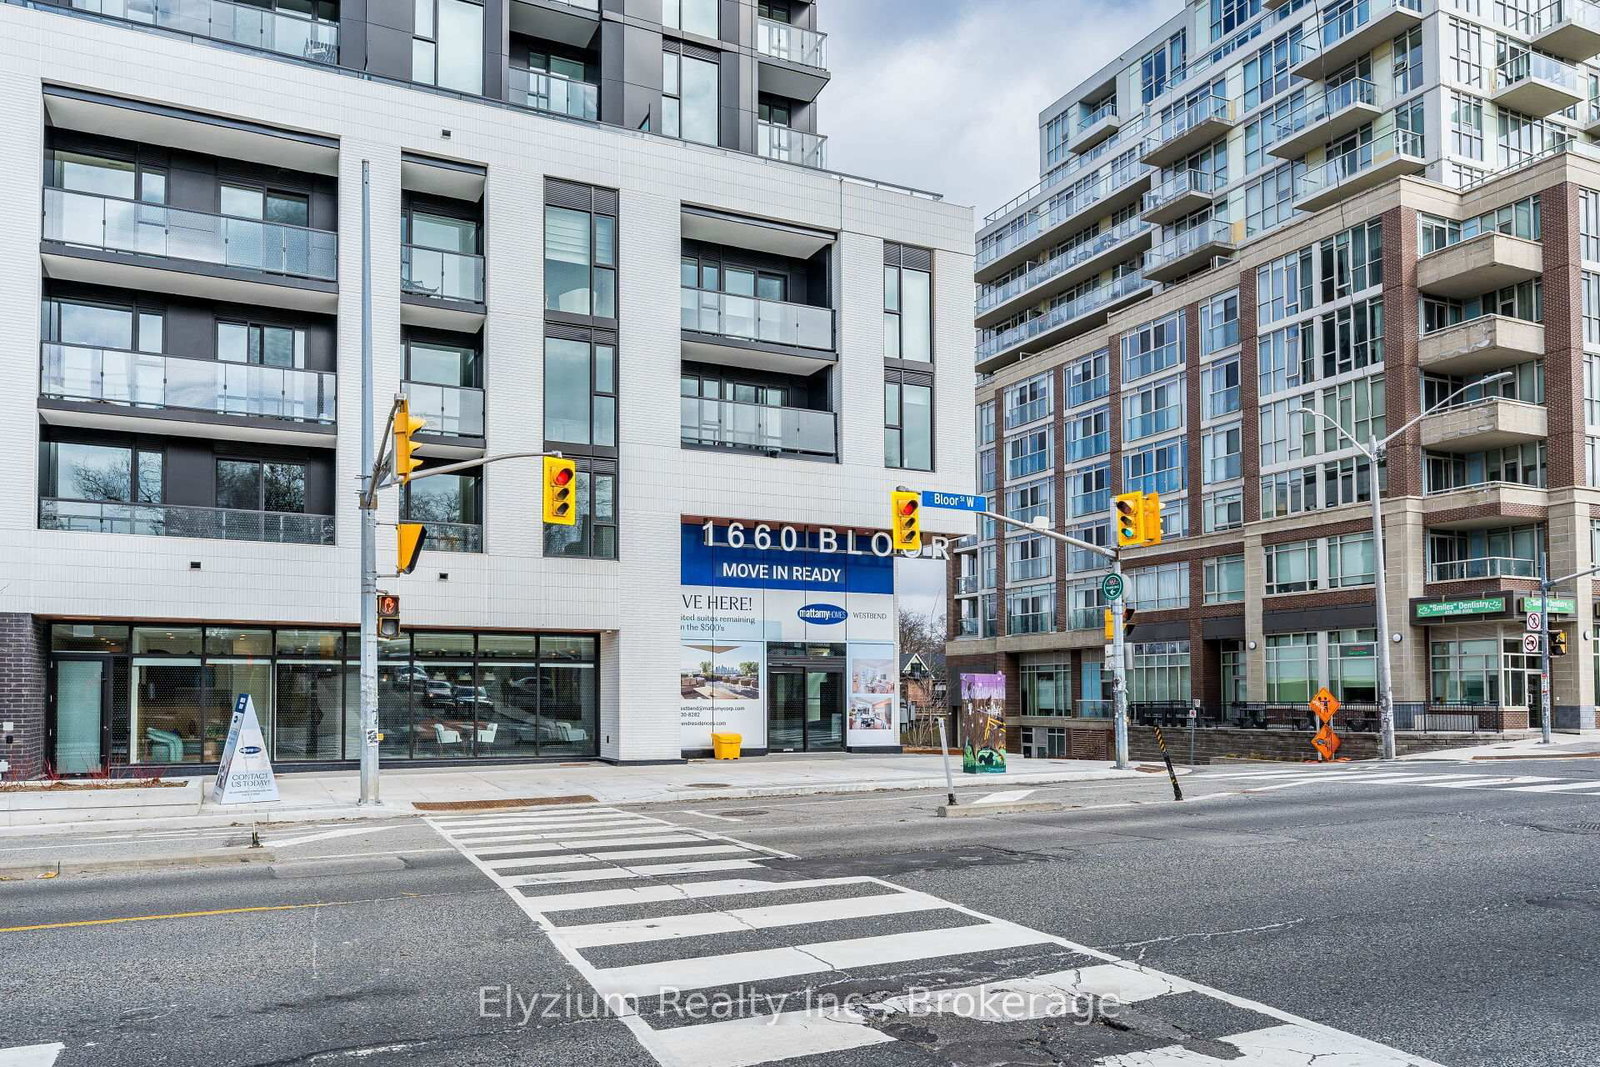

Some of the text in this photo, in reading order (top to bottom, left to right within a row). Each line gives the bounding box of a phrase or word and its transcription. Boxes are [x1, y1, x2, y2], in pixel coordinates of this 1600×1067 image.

[934, 493, 958, 505] Bloor
[966, 496, 975, 507] W
[702, 520, 797, 552] 1660
[722, 562, 841, 582] MOVE IN READY
[707, 595, 752, 611] HERE!
[1458, 600, 1489, 610] Dentistry
[697, 614, 718, 622] suites
[720, 615, 756, 625] remaining
[852, 612, 887, 620] WESTBEND
[686, 623, 699, 631] the
[700, 623, 725, 632] $500's
[231, 772, 269, 781] CONTACT
[231, 779, 271, 788] US TODAY!
